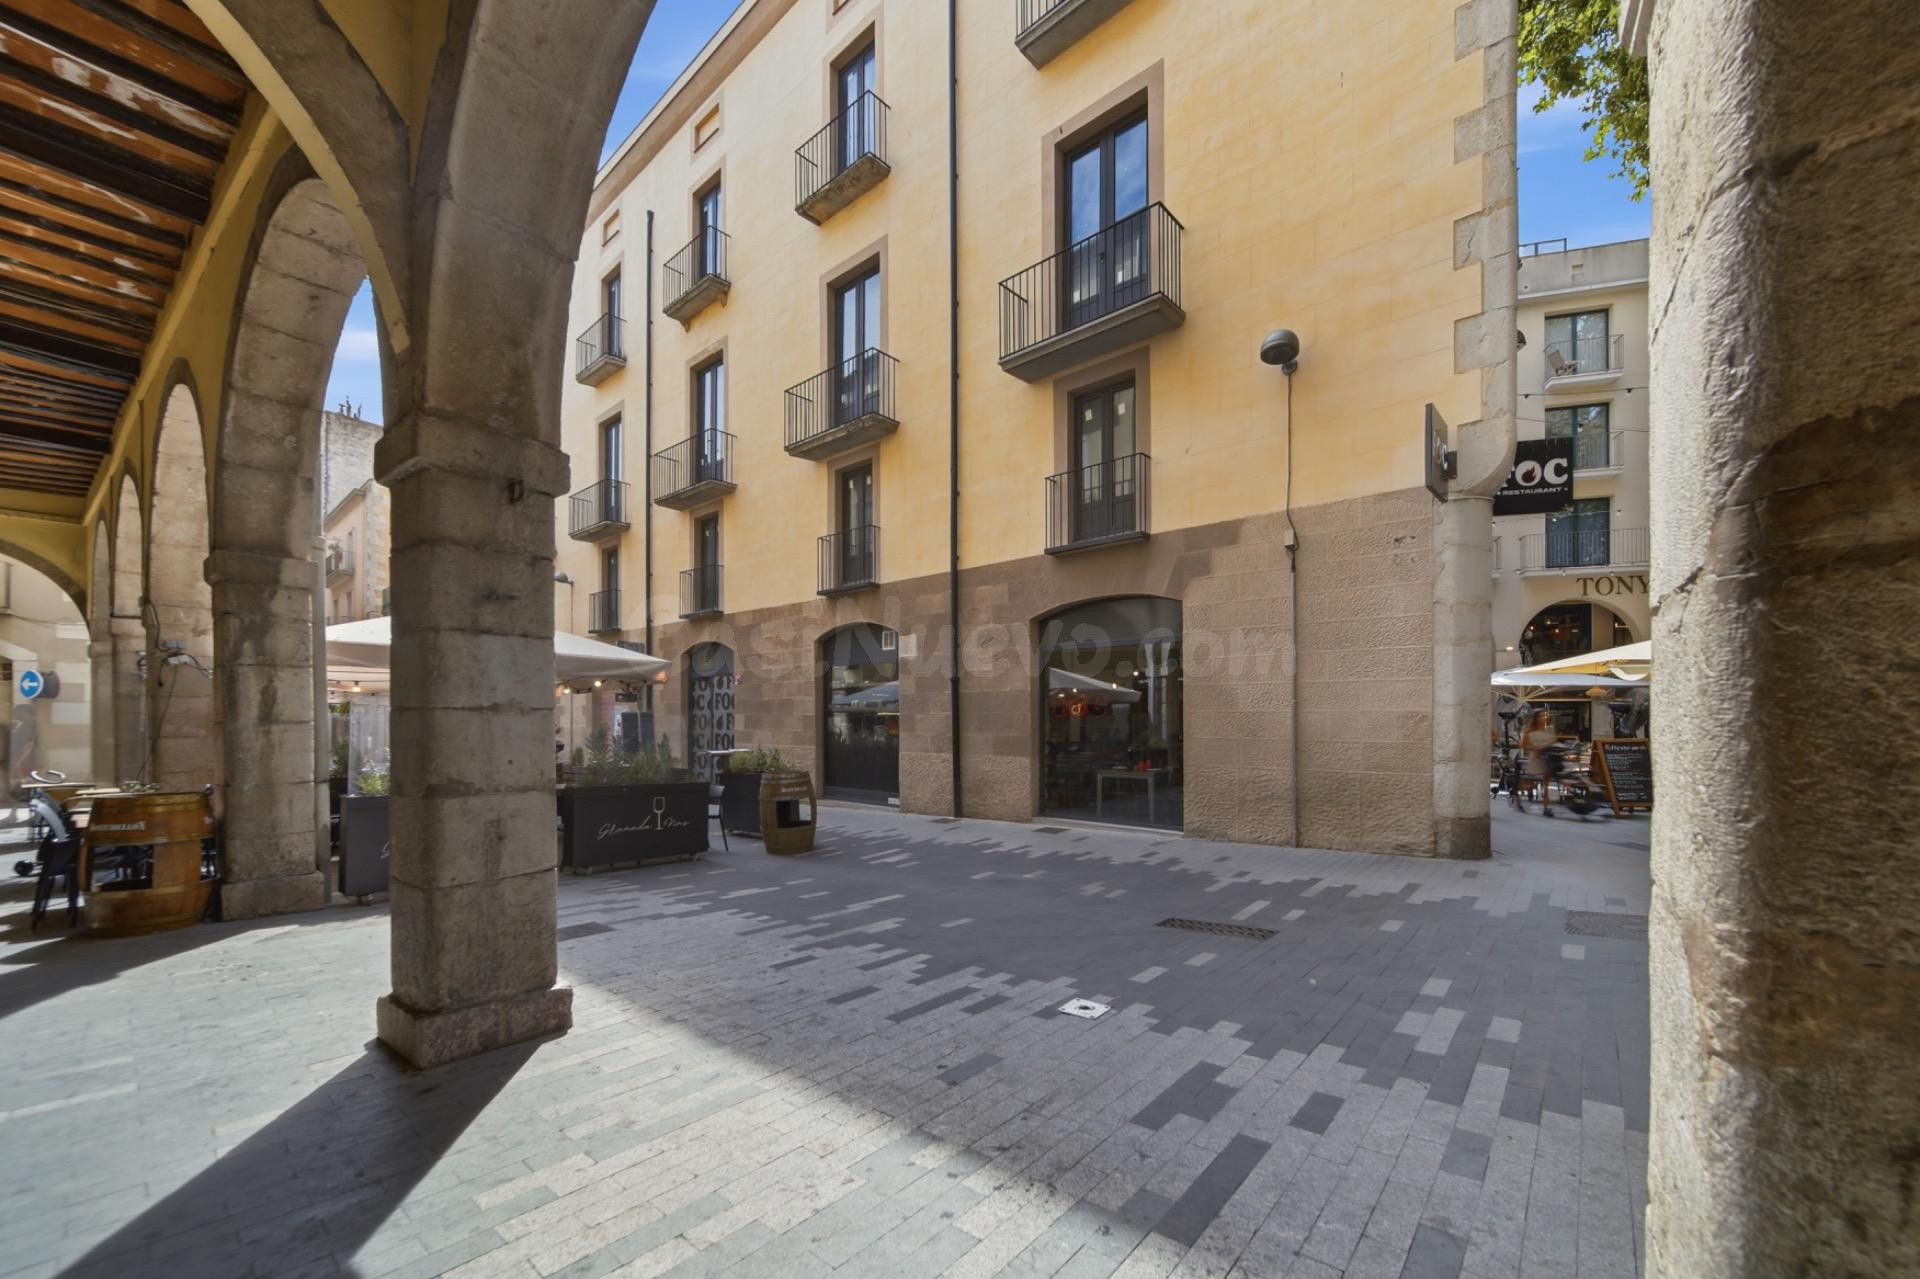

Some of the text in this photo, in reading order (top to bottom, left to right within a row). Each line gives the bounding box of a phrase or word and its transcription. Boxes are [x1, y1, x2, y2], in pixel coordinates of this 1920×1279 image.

[1502, 457, 1569, 487] OC
[1502, 487, 1562, 496] RESTAURANT
[1576, 575, 1649, 596] TONY
